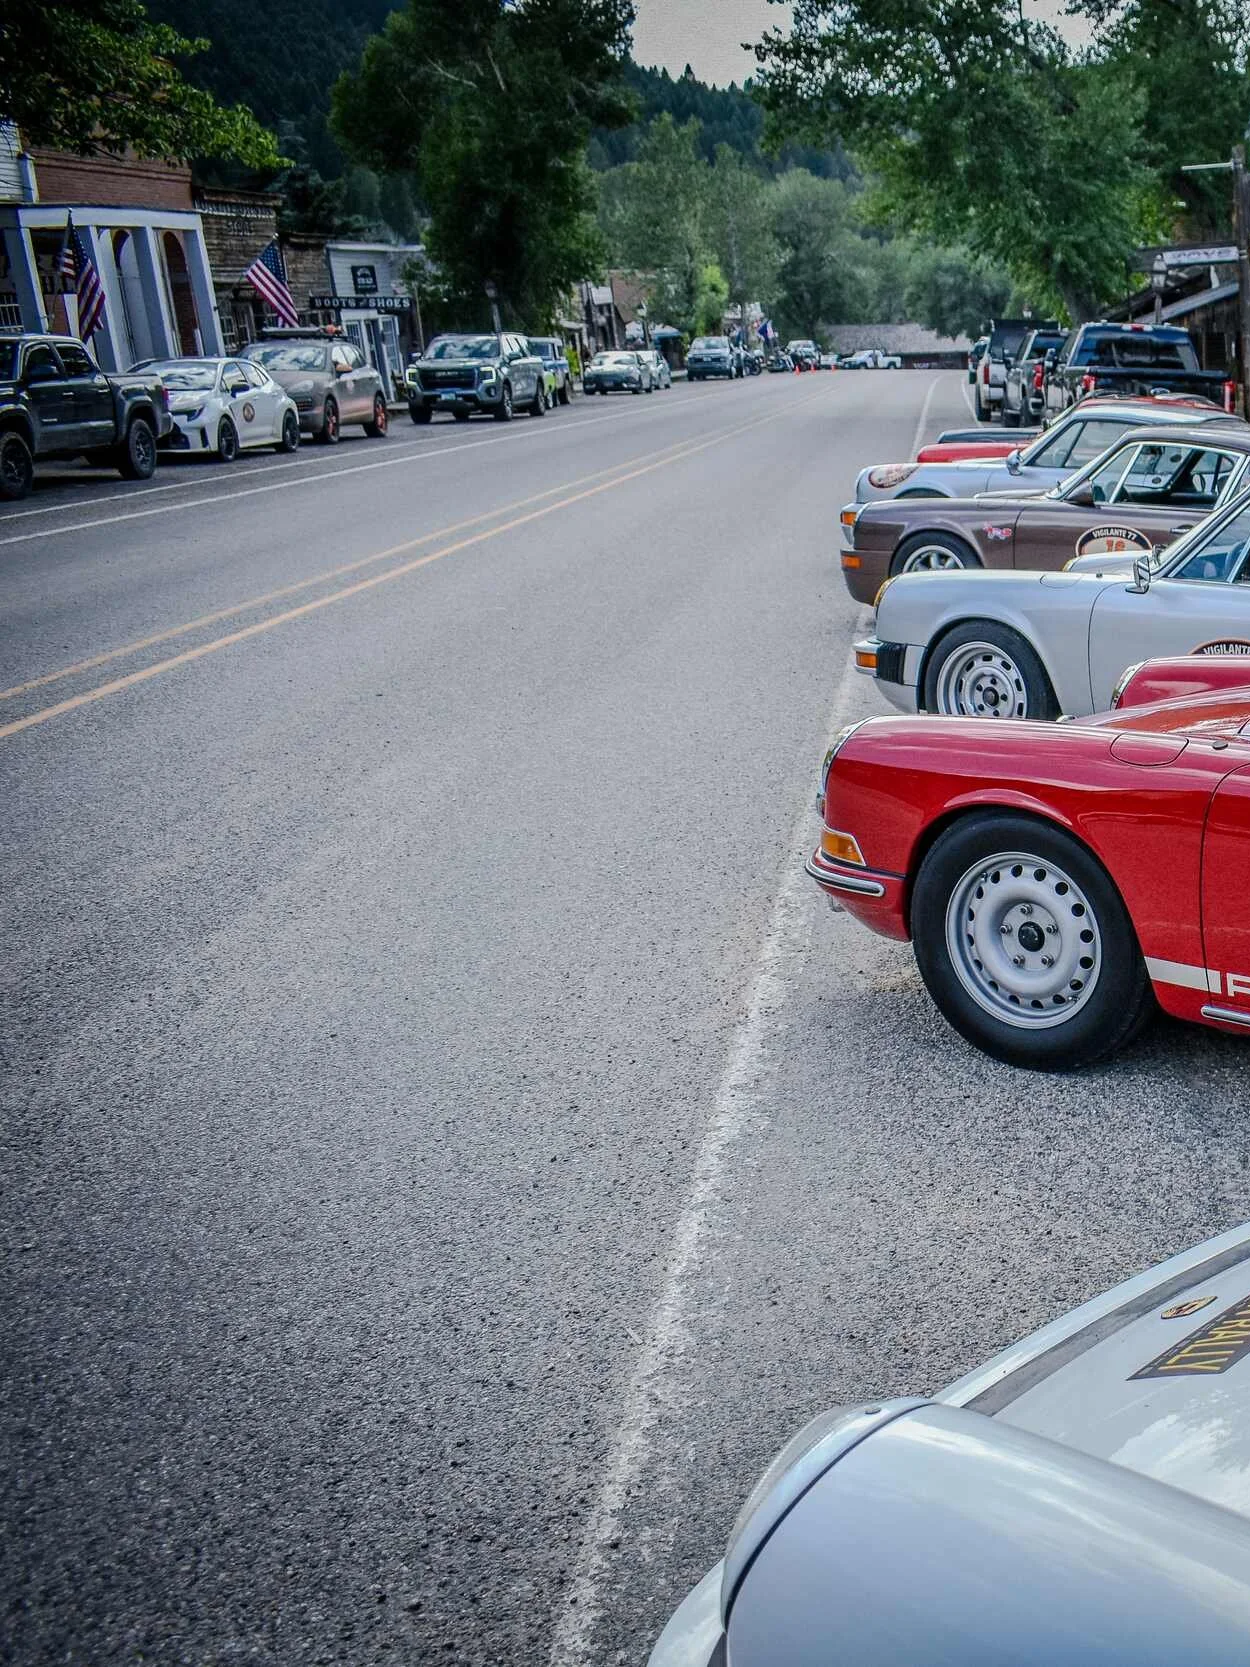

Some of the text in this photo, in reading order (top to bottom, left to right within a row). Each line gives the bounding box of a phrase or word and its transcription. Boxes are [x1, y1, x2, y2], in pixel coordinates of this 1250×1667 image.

[314, 298, 356, 307] BOOTS
[368, 298, 410, 308] SHOES
[1092, 528, 1137, 540] VIGILANTE 77
